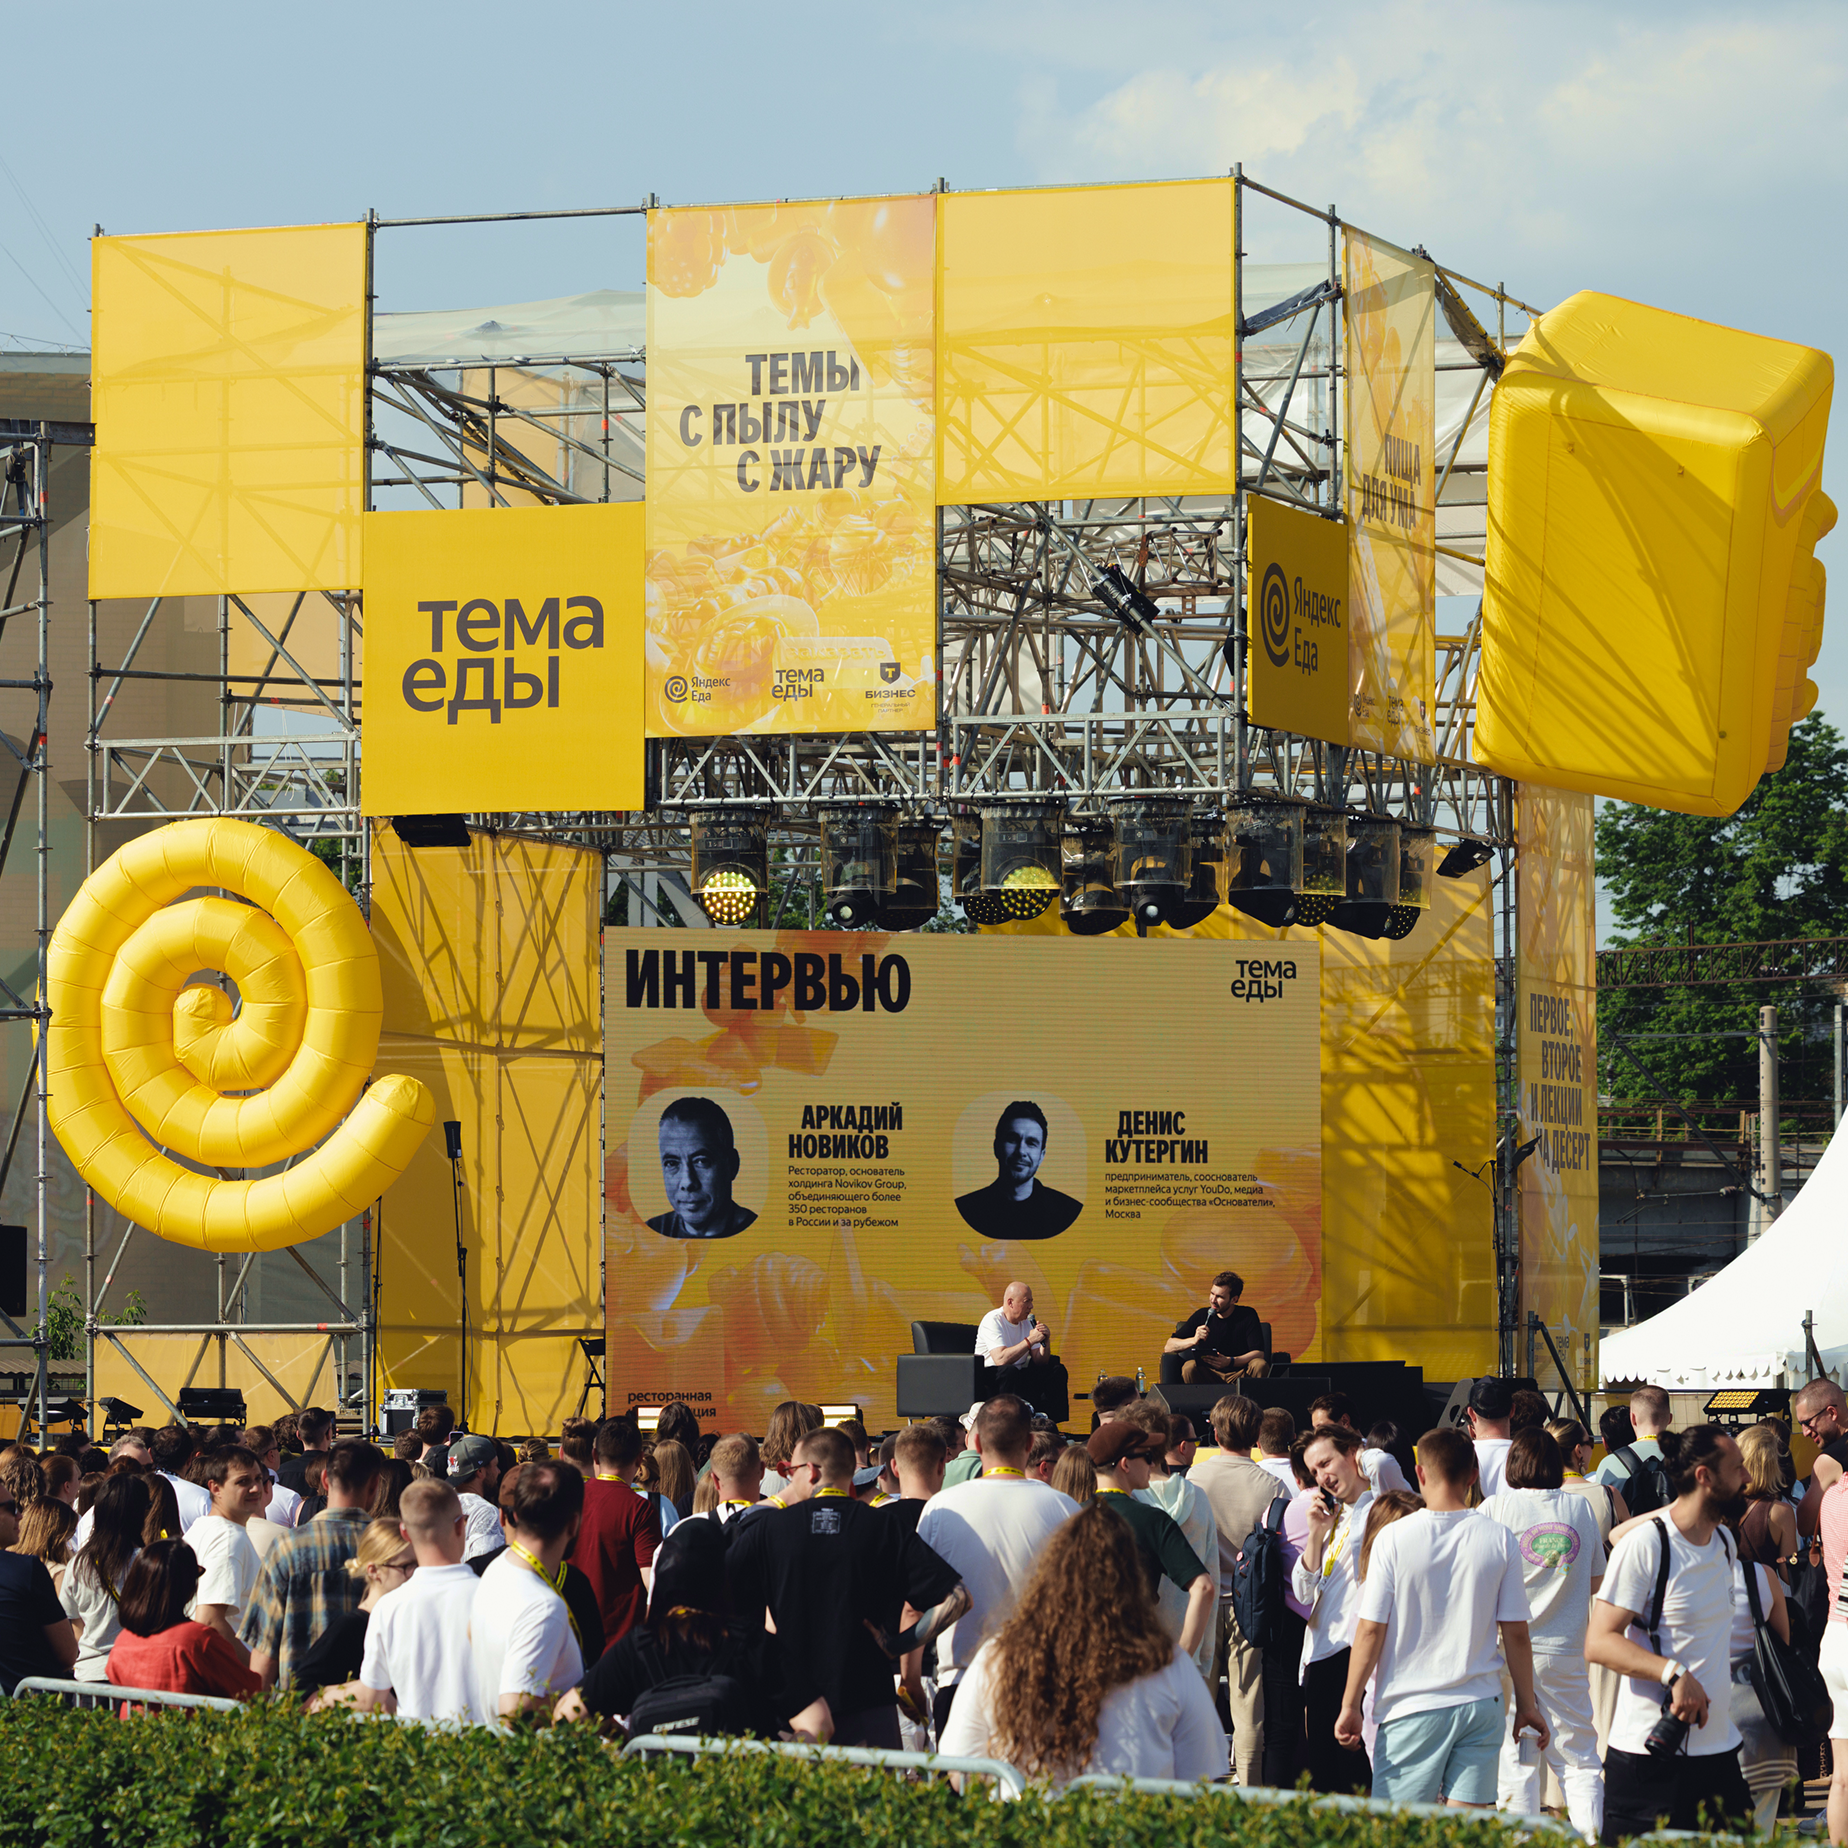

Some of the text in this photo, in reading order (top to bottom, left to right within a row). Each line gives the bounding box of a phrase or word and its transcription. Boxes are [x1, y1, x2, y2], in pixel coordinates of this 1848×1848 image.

[745, 350, 860, 396] ТЕМЫ
[679, 399, 827, 447] С ПЫЛУ
[737, 445, 882, 493] С ЖАРУ
[1384, 433, 1421, 489] ПИЩА
[1362, 473, 1416, 531] ДЛЯ УМА
[1294, 576, 1341, 629] Яндекс
[417, 595, 605, 653] тема
[1294, 627, 1319, 676] Еда
[691, 676, 731, 688] Яндекс
[776, 667, 824, 683] тема
[402, 655, 560, 725] еды
[691, 690, 712, 702] Еда
[771, 683, 813, 702] еды
[865, 689, 916, 699] БИЗНЕС
[626, 949, 911, 1013] ИНТЕРВЬЮ
[1235, 960, 1297, 979] тема
[1231, 979, 1283, 1003] еды
[1530, 993, 1573, 1042] ПЕРВОЕ,
[1541, 1040, 1582, 1083] ВТОРОЕ
[801, 1101, 902, 1134] АРКАДИЙ
[1530, 1083, 1582, 1130] И ЛЕКЦИИ
[1117, 1110, 1186, 1138] ДЕНИС
[788, 1134, 889, 1159] НОВИКОВ
[1105, 1139, 1209, 1164] КУТЕРГИН
[1552, 1129, 1591, 1174] ДЕСЕРТ
[788, 1166, 905, 1177] Ресторатор, основатель
[1105, 1174, 1258, 1182] предприниматель, сооснователь
[788, 1179, 907, 1190] холдинга Novikov Group,
[788, 1191, 901, 1202] объединяющего более
[1105, 1185, 1263, 1195] маркетплейса услуг YouDo, медиа
[788, 1204, 867, 1215] 350 ресторанов
[1105, 1210, 1141, 1219] Москва
[1113, 1197, 1207, 1207] бизнес-сообщества
[1208, 1197, 1276, 1208] «Основатели»,
[796, 1217, 831, 1227] России
[840, 1219, 851, 1227] за
[853, 1217, 899, 1228] рубежом
[628, 1391, 712, 1404] ресторанная
